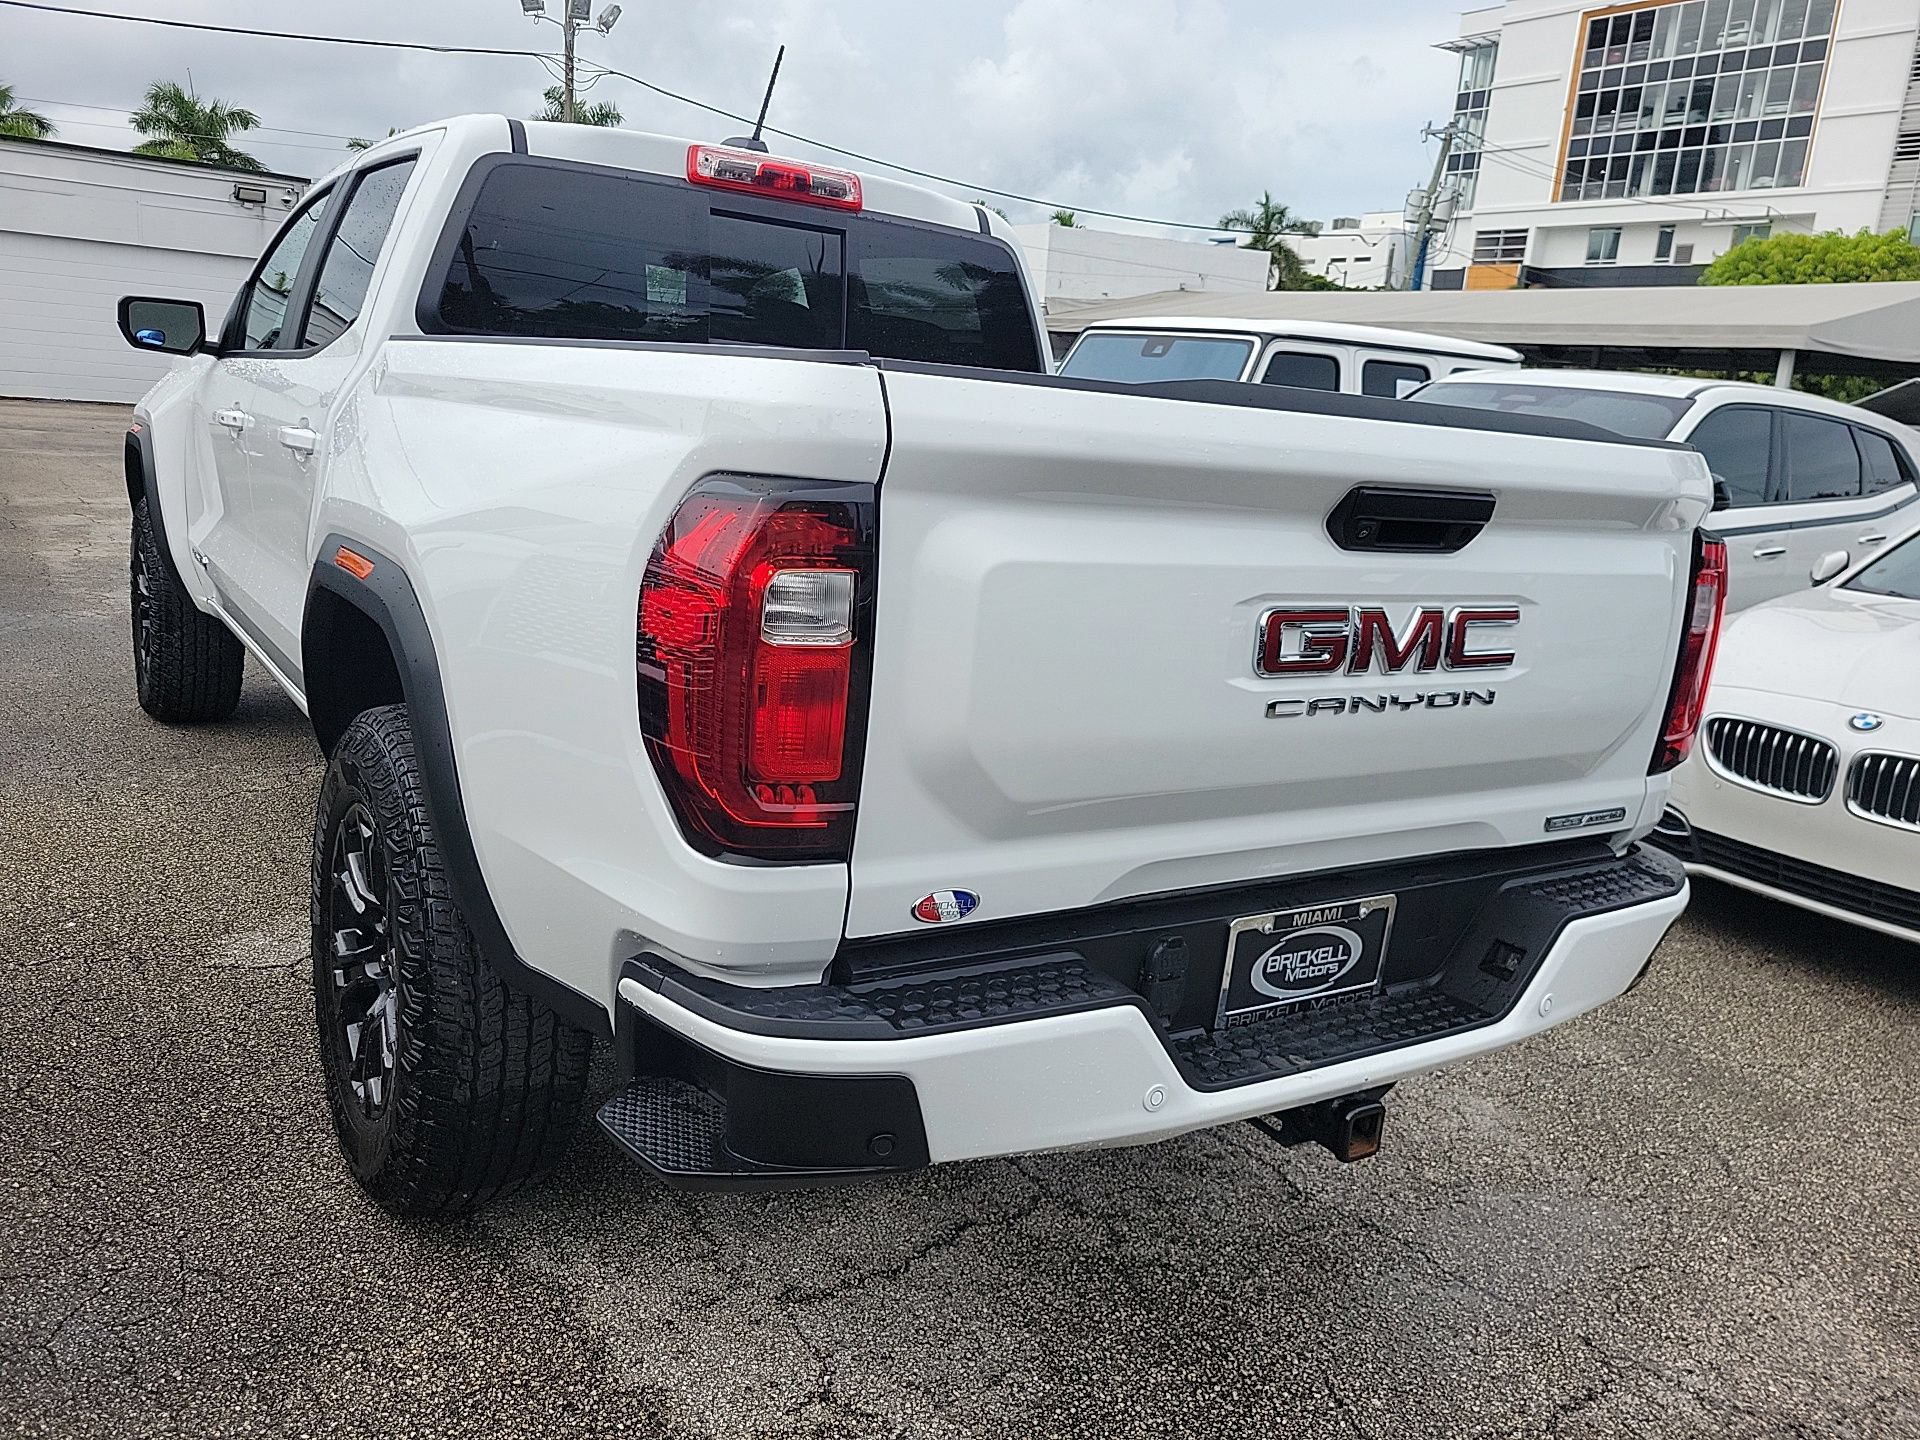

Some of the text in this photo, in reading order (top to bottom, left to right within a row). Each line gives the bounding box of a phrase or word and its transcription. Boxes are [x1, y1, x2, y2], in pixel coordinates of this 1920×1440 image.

[1253, 605, 1520, 679] GMC
[1264, 689, 1496, 719] CANYON
[1292, 907, 1343, 927] MIAMI
[1266, 944, 1348, 973] BRICKELL
[1284, 961, 1339, 983] Motors
